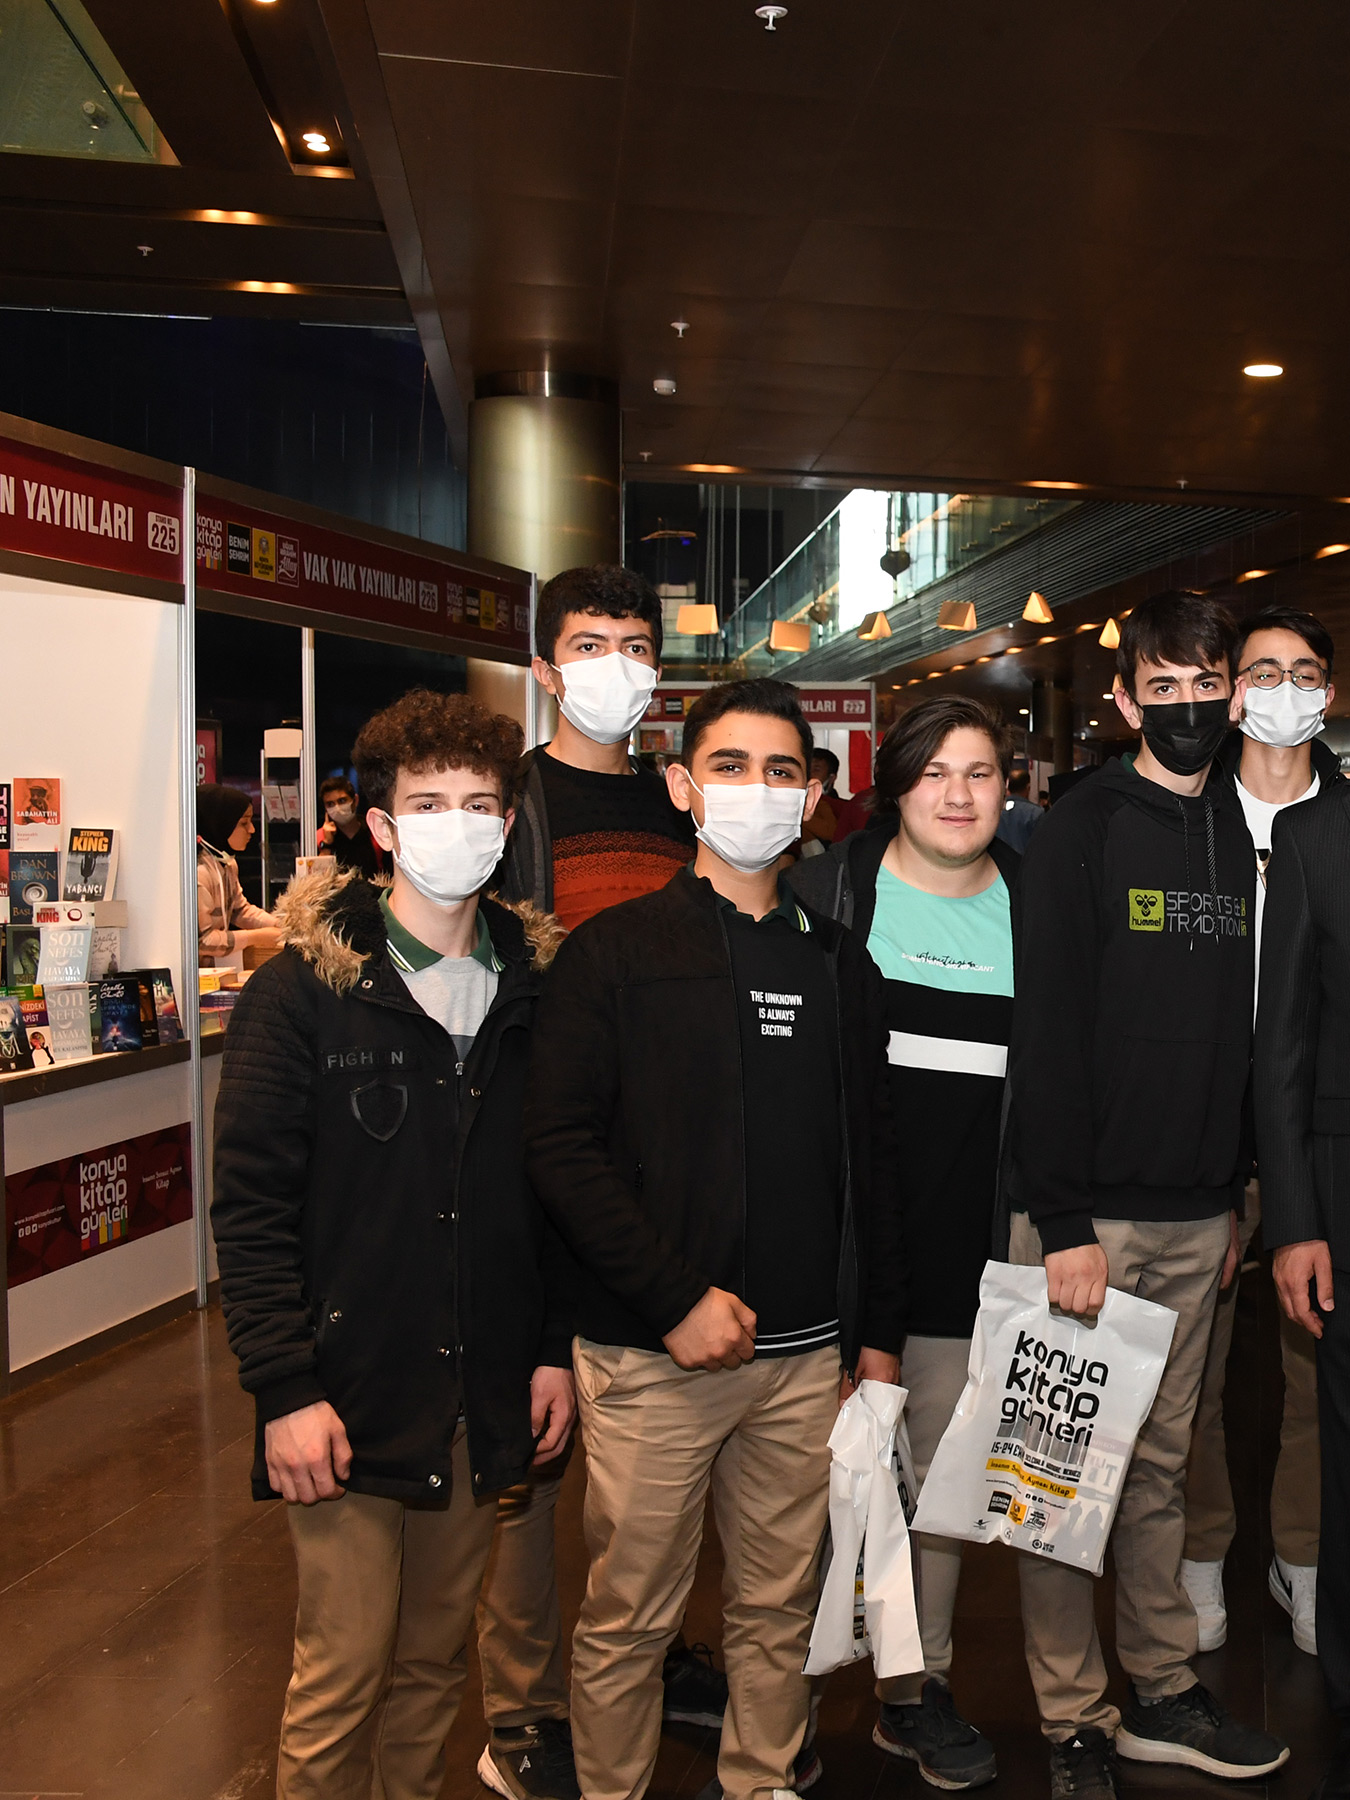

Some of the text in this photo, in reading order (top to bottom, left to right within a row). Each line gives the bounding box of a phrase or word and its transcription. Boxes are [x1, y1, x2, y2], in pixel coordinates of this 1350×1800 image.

[23, 479, 134, 542] YAYINLARI
[196, 512, 223, 534] konya
[151, 523, 177, 552] 225
[196, 526, 223, 550] kitap
[302, 551, 329, 585] VAK
[332, 558, 356, 591] VAK
[359, 565, 416, 605] YAYINLARI
[72, 836, 109, 852] KING
[20, 858, 47, 869] DAN
[10, 870, 57, 881] BROWN
[1166, 891, 1233, 915] SPORTS
[36, 912, 60, 923] KING
[1131, 916, 1163, 927] hummel
[1166, 913, 1241, 937] TRADITION
[44, 965, 82, 976] HAVAYA
[749, 990, 803, 1006] THE UNKNOWN
[758, 1007, 796, 1022] IS ALWAYS
[761, 1023, 793, 1037] EXCITING
[80, 1153, 127, 1184] konya
[80, 1178, 128, 1213] kitap
[80, 1200, 128, 1240] günleri
[1014, 1330, 1109, 1387] konya
[1005, 1357, 1101, 1423] kitap
[1000, 1397, 1094, 1447] günleri
[991, 1441, 1014, 1455] 15-24
[1049, 1483, 1071, 1497] Kitap
